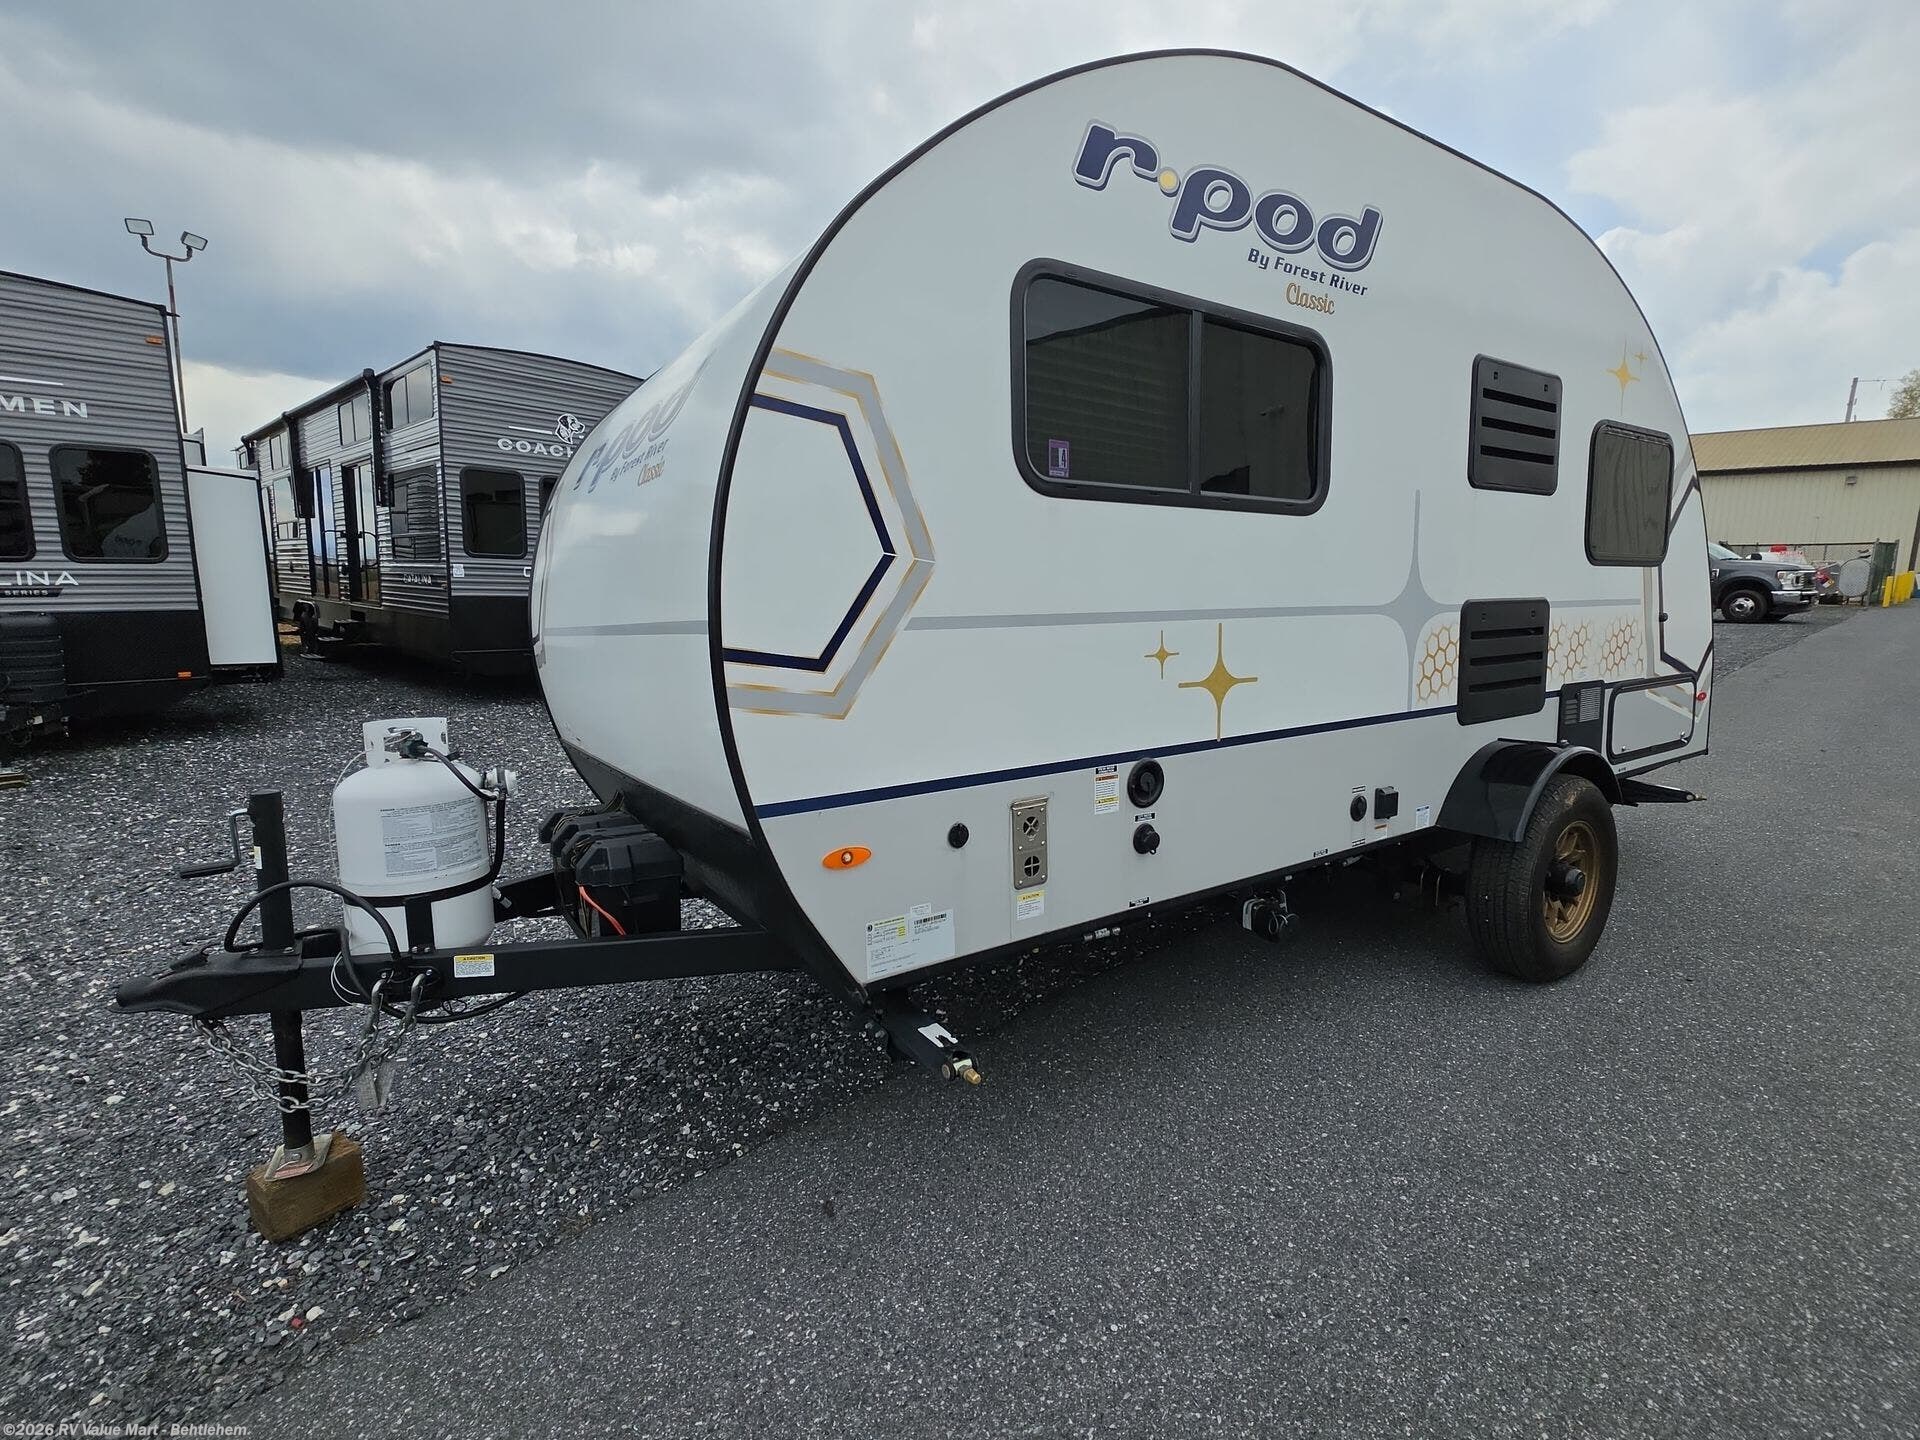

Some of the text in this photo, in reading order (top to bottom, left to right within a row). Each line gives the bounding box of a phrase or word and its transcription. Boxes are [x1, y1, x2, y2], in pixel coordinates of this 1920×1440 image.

[1248, 248, 1368, 296] By Forest River
[1286, 283, 1335, 315] Classic
[0, 395, 88, 418] MEN
[620, 452, 645, 476] Forest
[644, 438, 669, 461] River
